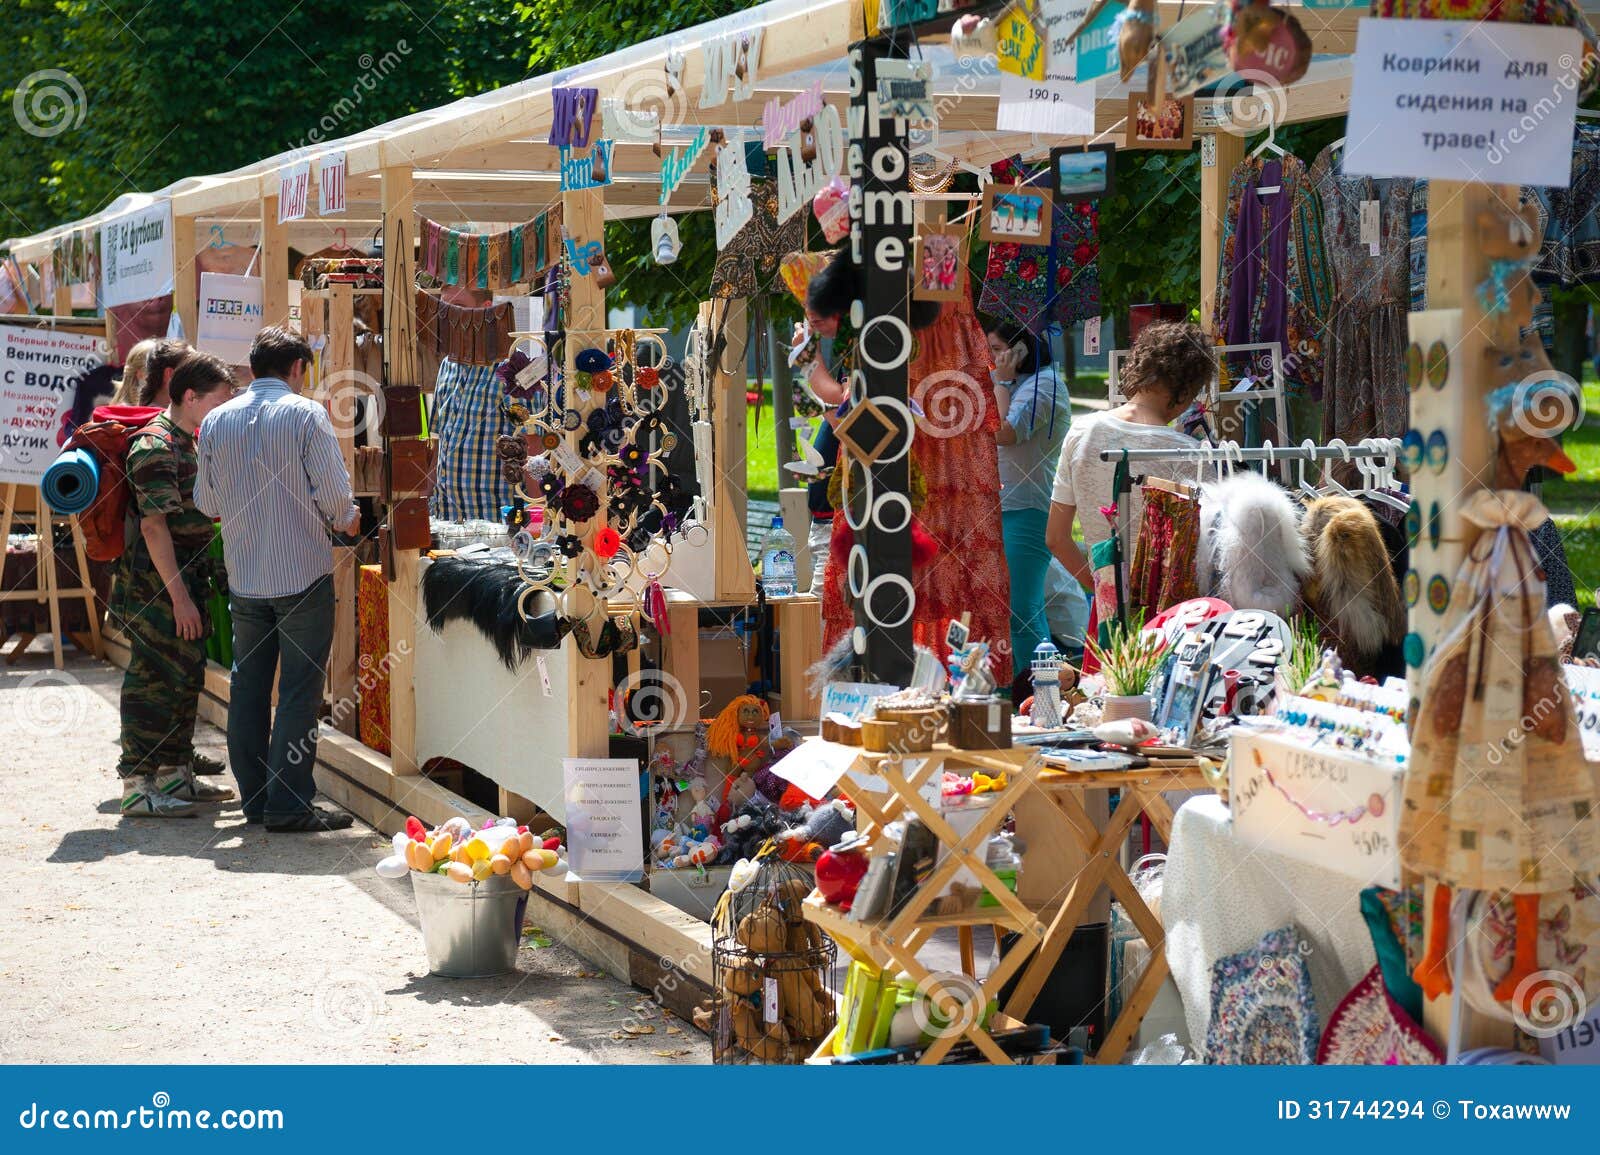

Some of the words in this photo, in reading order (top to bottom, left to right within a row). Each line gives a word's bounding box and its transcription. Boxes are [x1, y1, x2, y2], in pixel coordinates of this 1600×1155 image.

[1381, 52, 1480, 75] Коврики
[1504, 60, 1548, 79] для
[1029, 88, 1049, 100] 190
[1053, 93, 1063, 104] р.
[1396, 93, 1493, 112] сидения
[1500, 98, 1527, 113] на
[1422, 129, 1495, 151] траве!
[207, 299, 242, 316] HERE
[7, 334, 49, 347] Впервые
[58, 339, 97, 352] России!
[7, 347, 95, 371] Вентилятор
